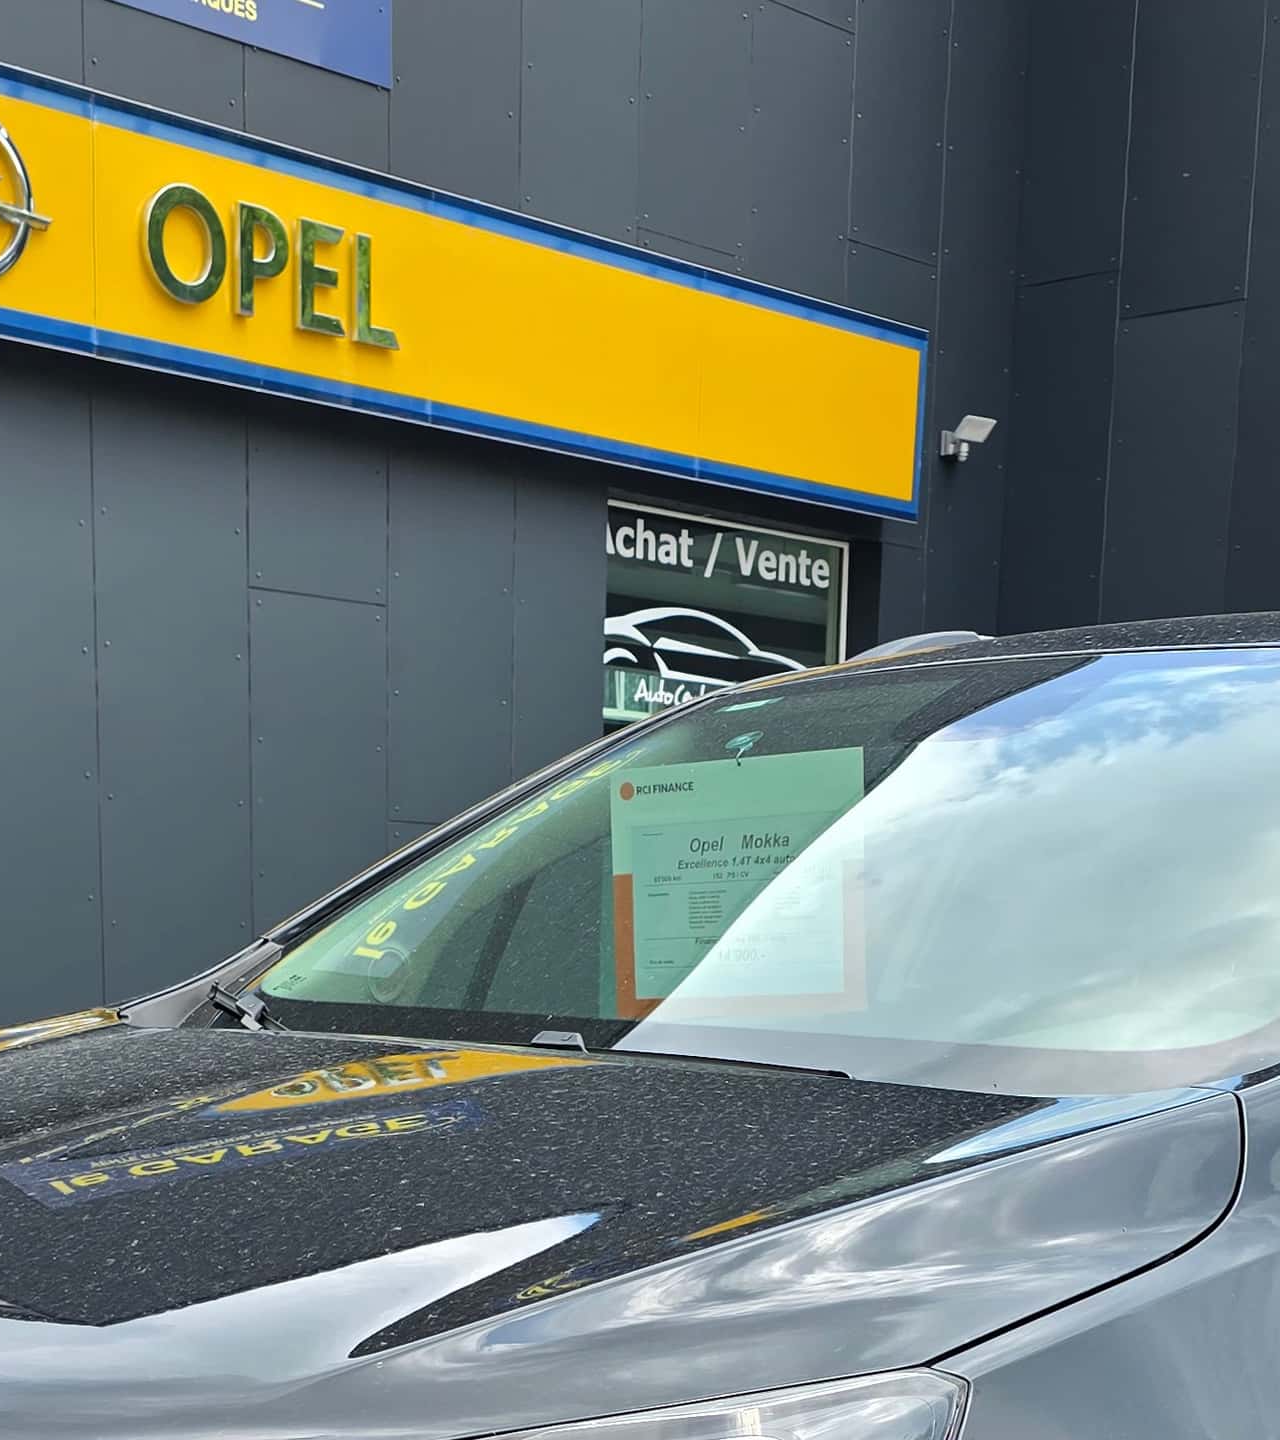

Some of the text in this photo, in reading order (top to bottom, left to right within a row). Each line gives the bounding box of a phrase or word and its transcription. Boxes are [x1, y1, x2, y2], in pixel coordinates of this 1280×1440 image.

[187, 0, 257, 21] QUES
[145, 182, 401, 350] OPEL
[735, 536, 831, 589] Vente
[652, 781, 695, 794] FINANCE
[689, 832, 790, 856] Opel Mokka
[677, 857, 729, 871] Excellence
[754, 855, 771, 865] 4x4
